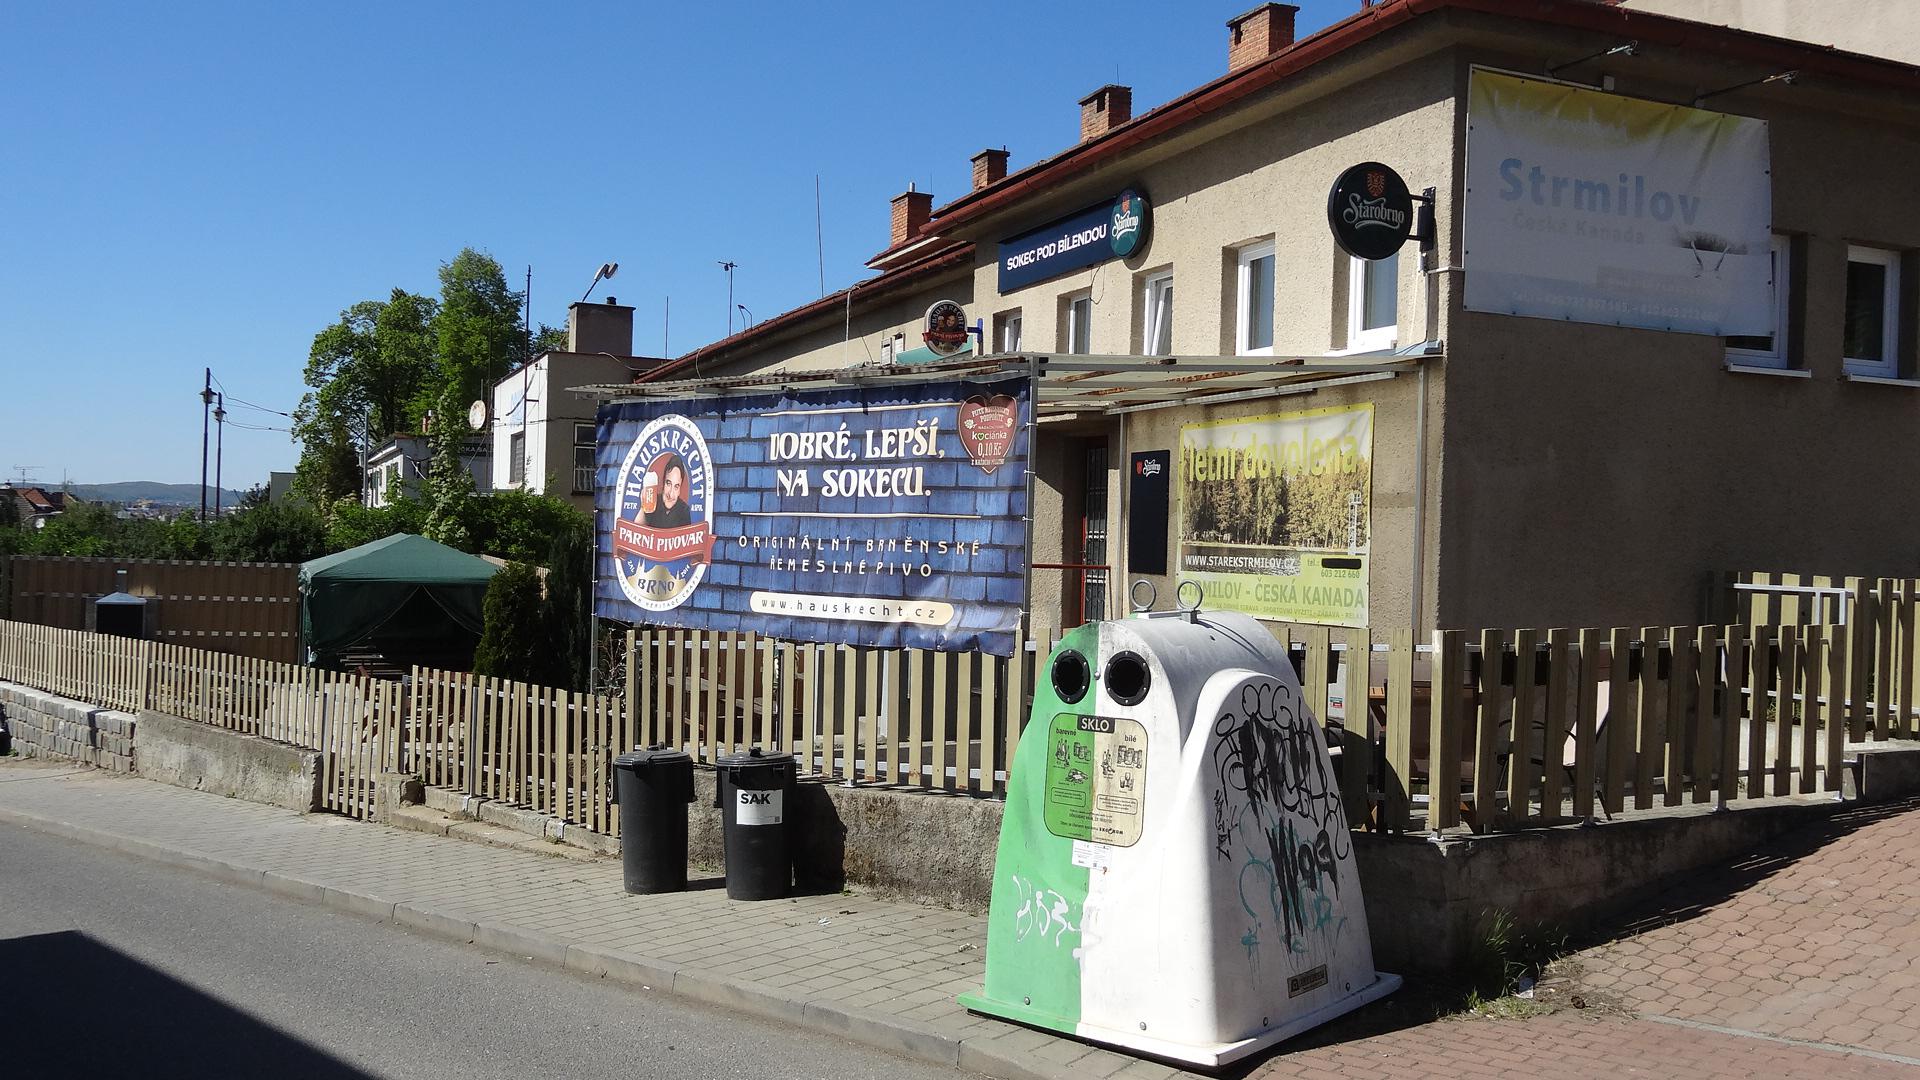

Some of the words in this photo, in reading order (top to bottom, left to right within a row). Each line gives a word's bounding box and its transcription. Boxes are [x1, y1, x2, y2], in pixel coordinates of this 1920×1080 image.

[1499, 158, 1699, 226] Strmilov
[1343, 192, 1405, 230] Starobrno
[1007, 249, 1036, 271] SOKEC
[1036, 242, 1056, 261] POD
[1057, 223, 1107, 254] BÍLENDOU
[865, 416, 945, 459] LEPŠÍ,
[977, 442, 993, 458] 0,10
[1189, 431, 1237, 482] letní
[1243, 418, 1358, 480] dovolená
[625, 429, 705, 499] HAUSKRECHT
[776, 469, 809, 497] NA
[821, 466, 932, 498] SOKECU.
[619, 527, 654, 550] PARNÍ
[656, 530, 704, 552] PIVOVAR
[738, 534, 851, 552] ORIGINÁLNÍ
[866, 535, 981, 556] BRNĚNSKÉ
[770, 554, 866, 575] ŘEMESLNÉ
[876, 560, 932, 578] PIVO
[638, 578, 675, 595] BRNO
[1255, 578, 1301, 604] ČESKÁ
[1302, 585, 1366, 609] KANADA
[1081, 716, 1110, 732] SKLO
[740, 793, 771, 805] SAK
